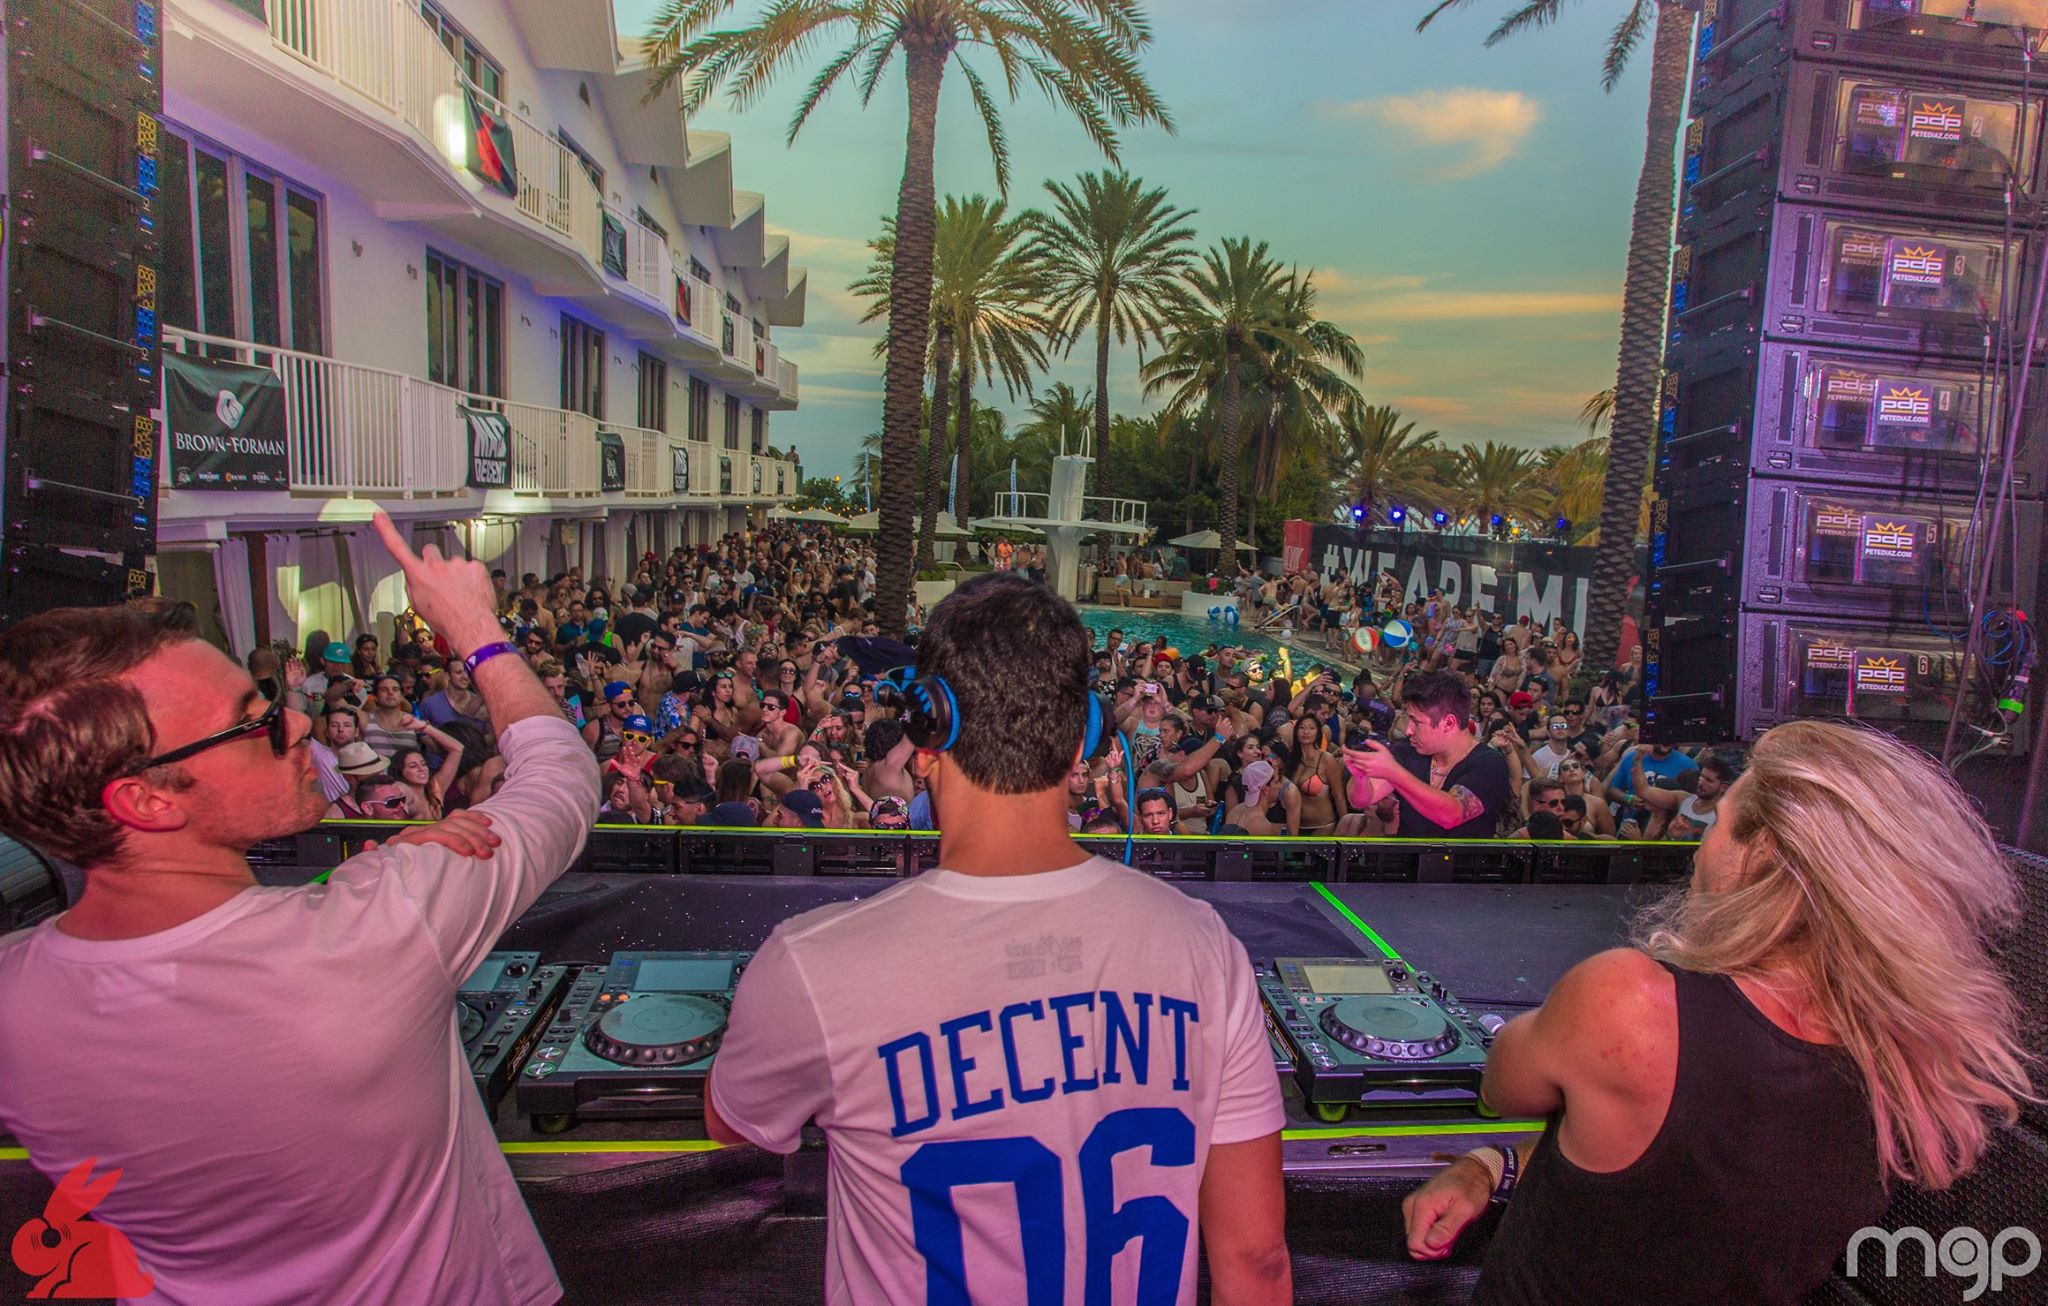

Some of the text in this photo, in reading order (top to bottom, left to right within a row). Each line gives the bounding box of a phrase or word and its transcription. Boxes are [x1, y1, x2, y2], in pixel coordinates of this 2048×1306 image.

[1911, 113, 1962, 131] pdp
[1972, 117, 1983, 137] 2
[1910, 129, 1961, 141] PETEDIAZ.COM
[1893, 257, 1943, 275] pdp
[1954, 256, 1965, 275] 3
[1891, 273, 1942, 284] PETEDIAZ.COM
[1880, 398, 1930, 415] pdp
[1940, 391, 1950, 411] 4
[1879, 413, 1929, 424] PETEDIAZ.COM
[174, 431, 285, 456] BROWN-FORMAN
[1865, 532, 1913, 549] pdp
[1926, 525, 1937, 544] 5
[1864, 548, 1912, 558] PETEDIAZ.COM
[1918, 655, 1928, 675] 6
[1857, 666, 1906, 683] pdp
[1856, 682, 1905, 692] PETEDIAZ.COM
[877, 989, 1200, 1138] DECENT
[899, 1106, 1197, 1306] 06
